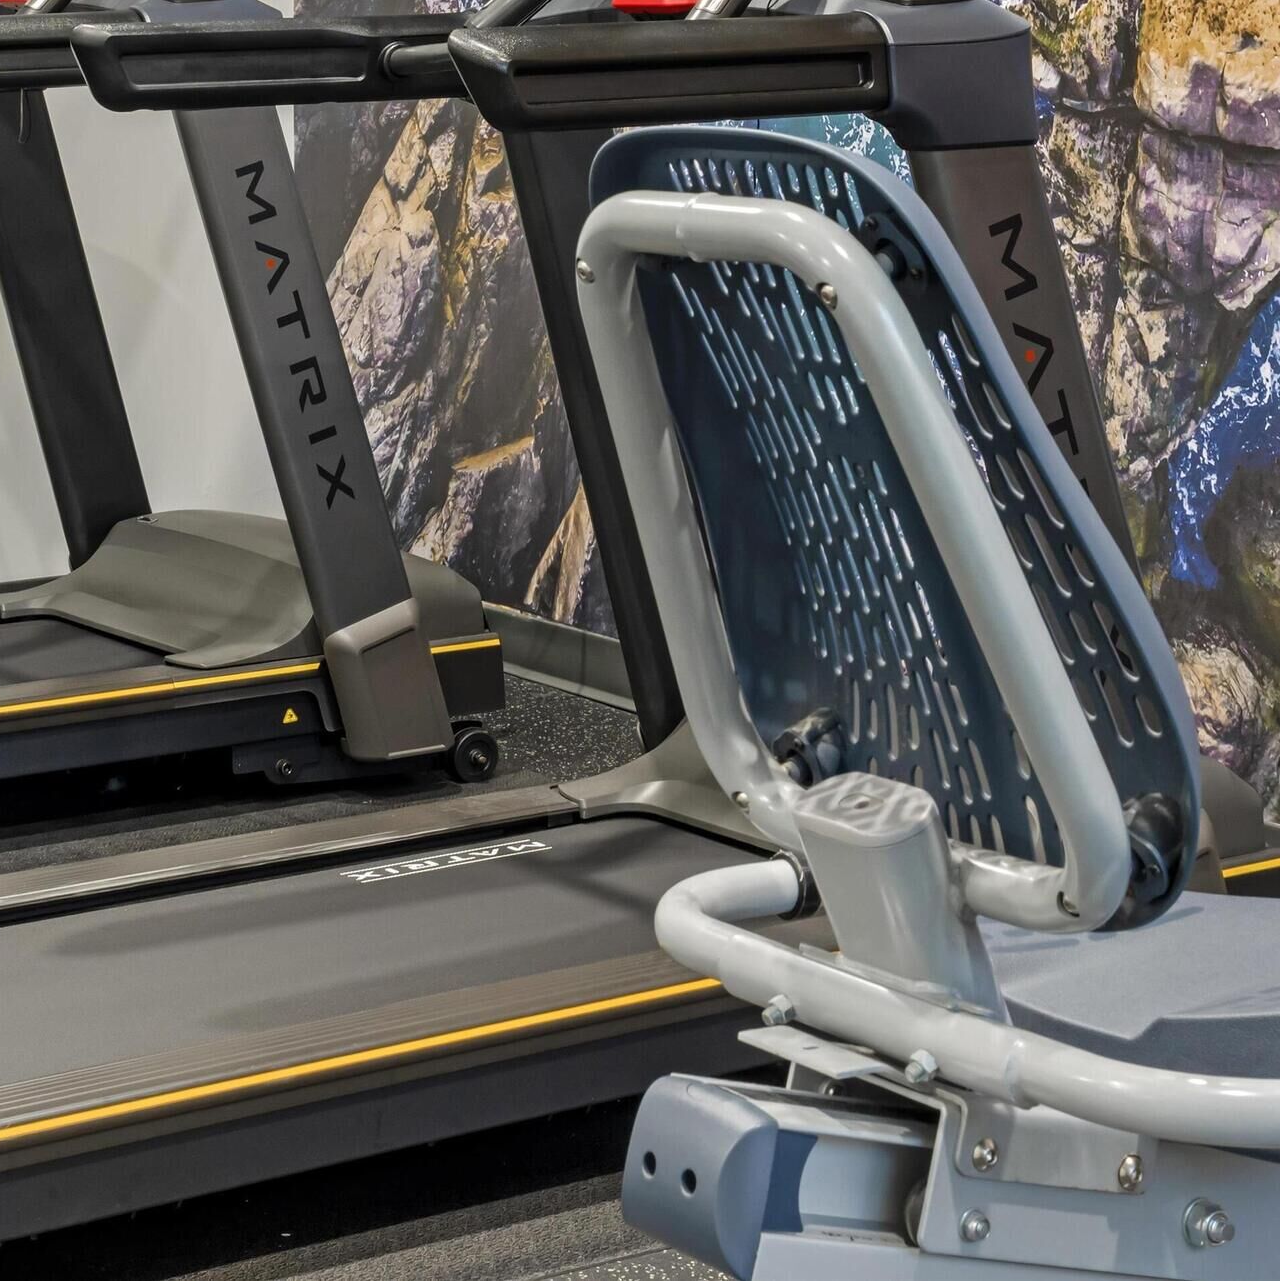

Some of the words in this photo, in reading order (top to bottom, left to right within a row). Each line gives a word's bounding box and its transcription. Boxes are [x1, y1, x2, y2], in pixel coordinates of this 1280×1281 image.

[235, 160, 356, 511] MATRIX
[988, 213, 1086, 495] MAT
[348, 840, 546, 881] MATRIX
